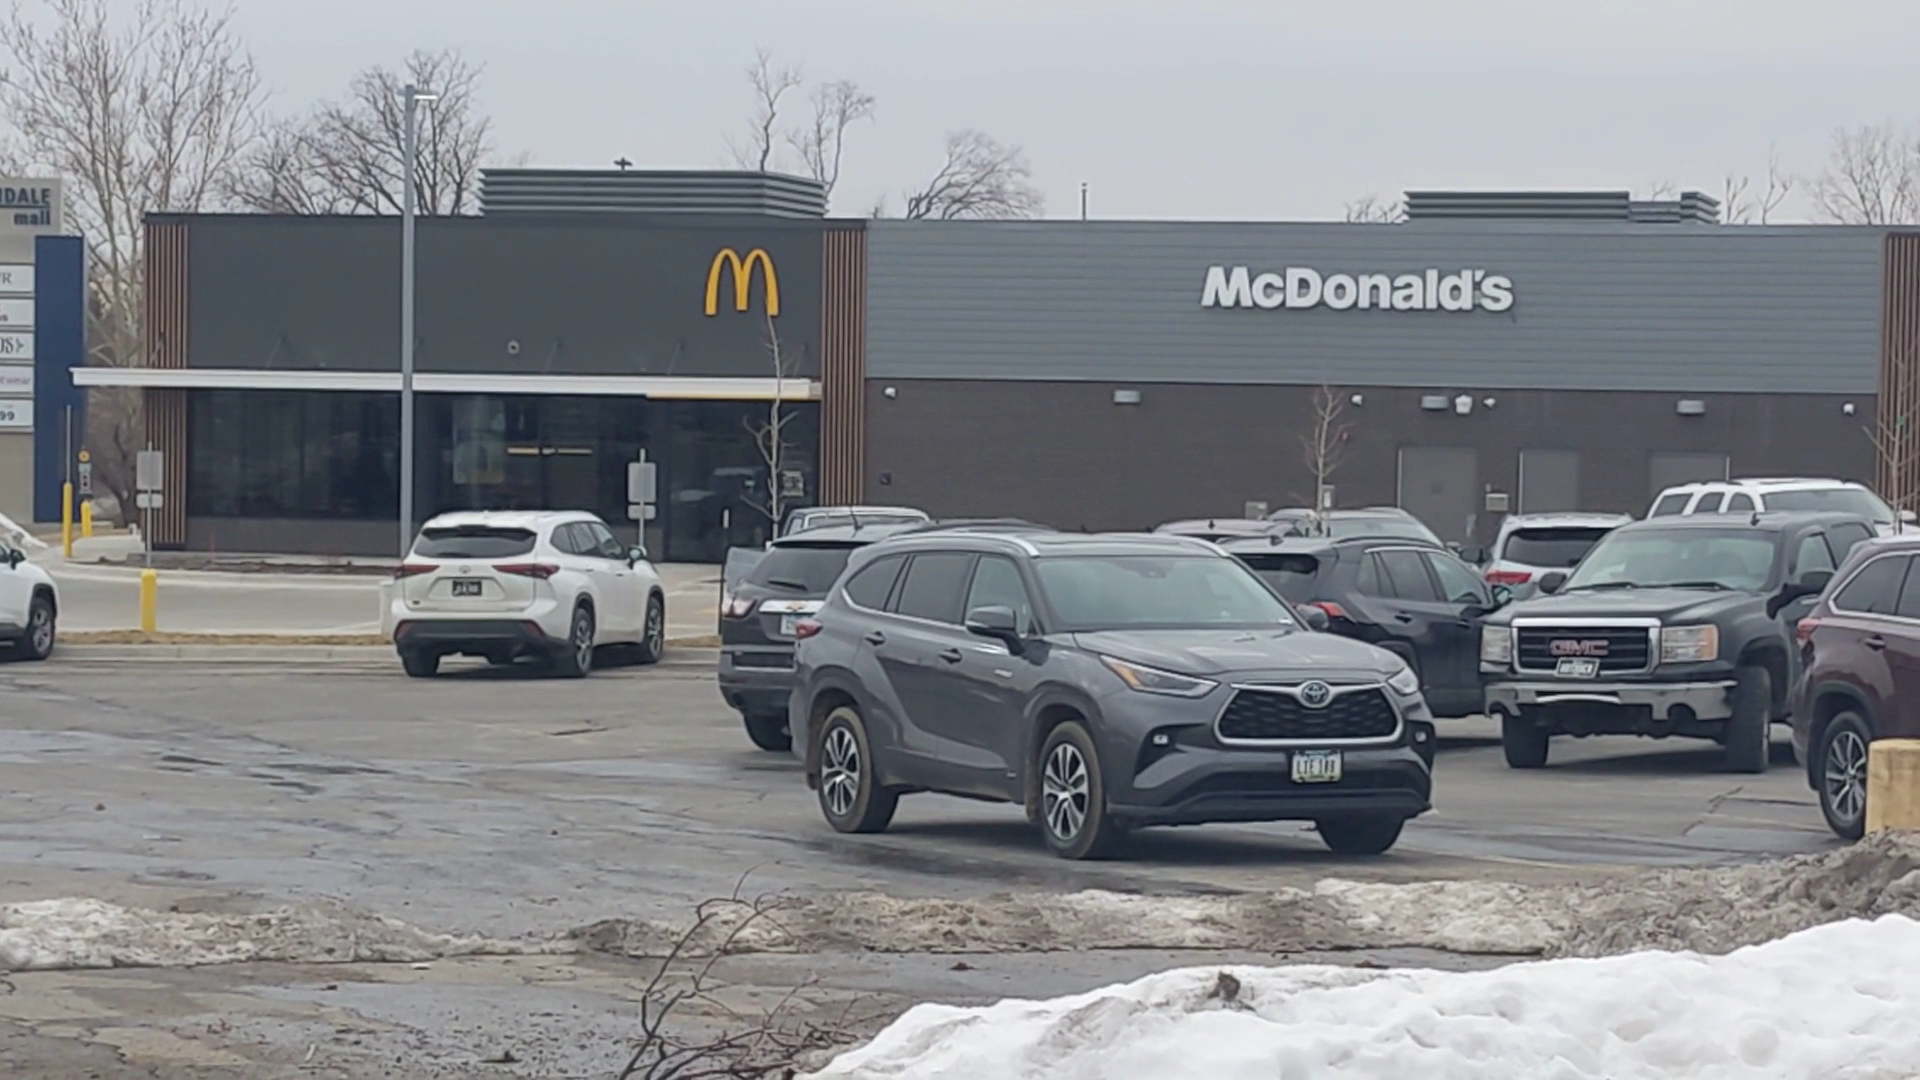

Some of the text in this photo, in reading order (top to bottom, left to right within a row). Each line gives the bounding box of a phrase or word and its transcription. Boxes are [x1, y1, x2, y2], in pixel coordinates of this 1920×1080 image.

[0, 187, 51, 204] DALE
[14, 210, 51, 225] mall
[1200, 266, 1515, 312] McDonald's
[1549, 639, 1610, 656] GMC
